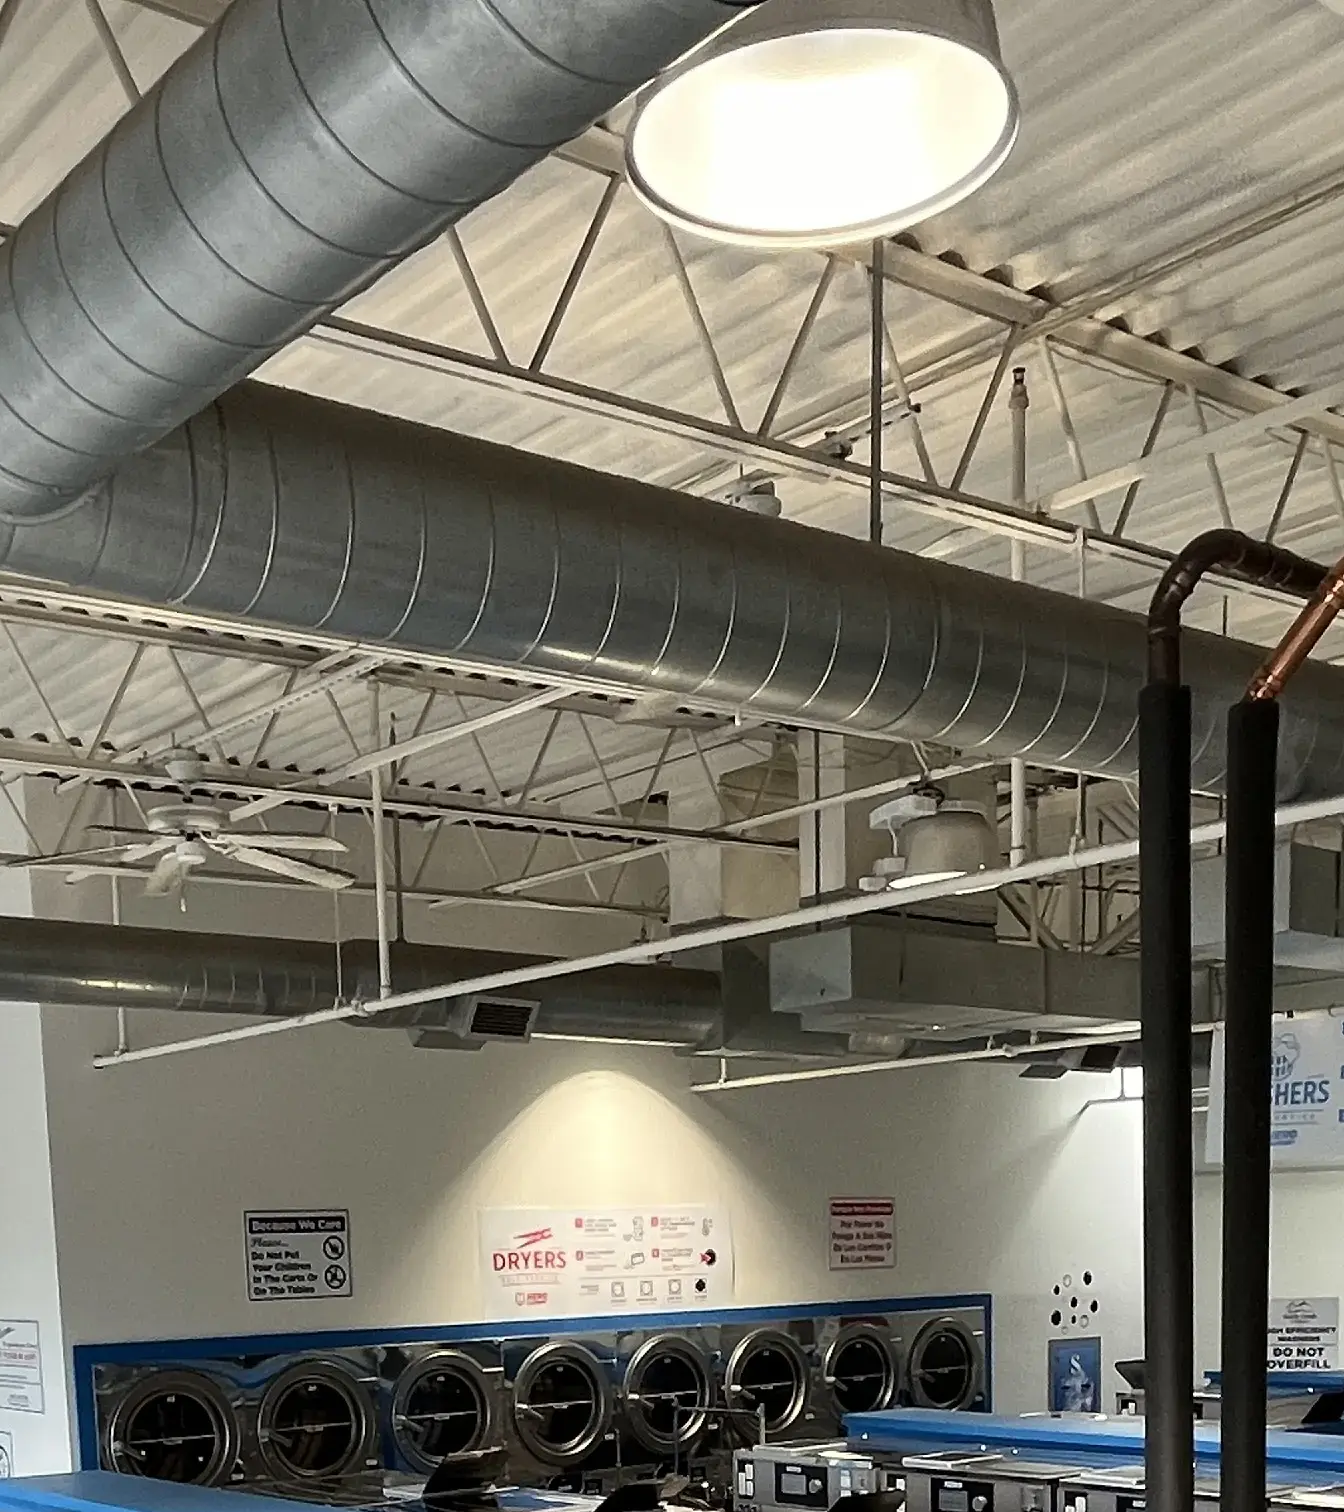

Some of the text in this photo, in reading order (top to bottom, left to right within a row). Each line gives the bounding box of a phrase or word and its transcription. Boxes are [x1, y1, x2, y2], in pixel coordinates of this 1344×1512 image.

[1271, 1080, 1330, 1106] HERS
[298, 1219, 316, 1230] We
[317, 1219, 342, 1230] Care
[492, 1251, 567, 1272] DRYERS
[1273, 1347, 1325, 1357] DO NOT
[1266, 1359, 1332, 1369] OVERFILL
